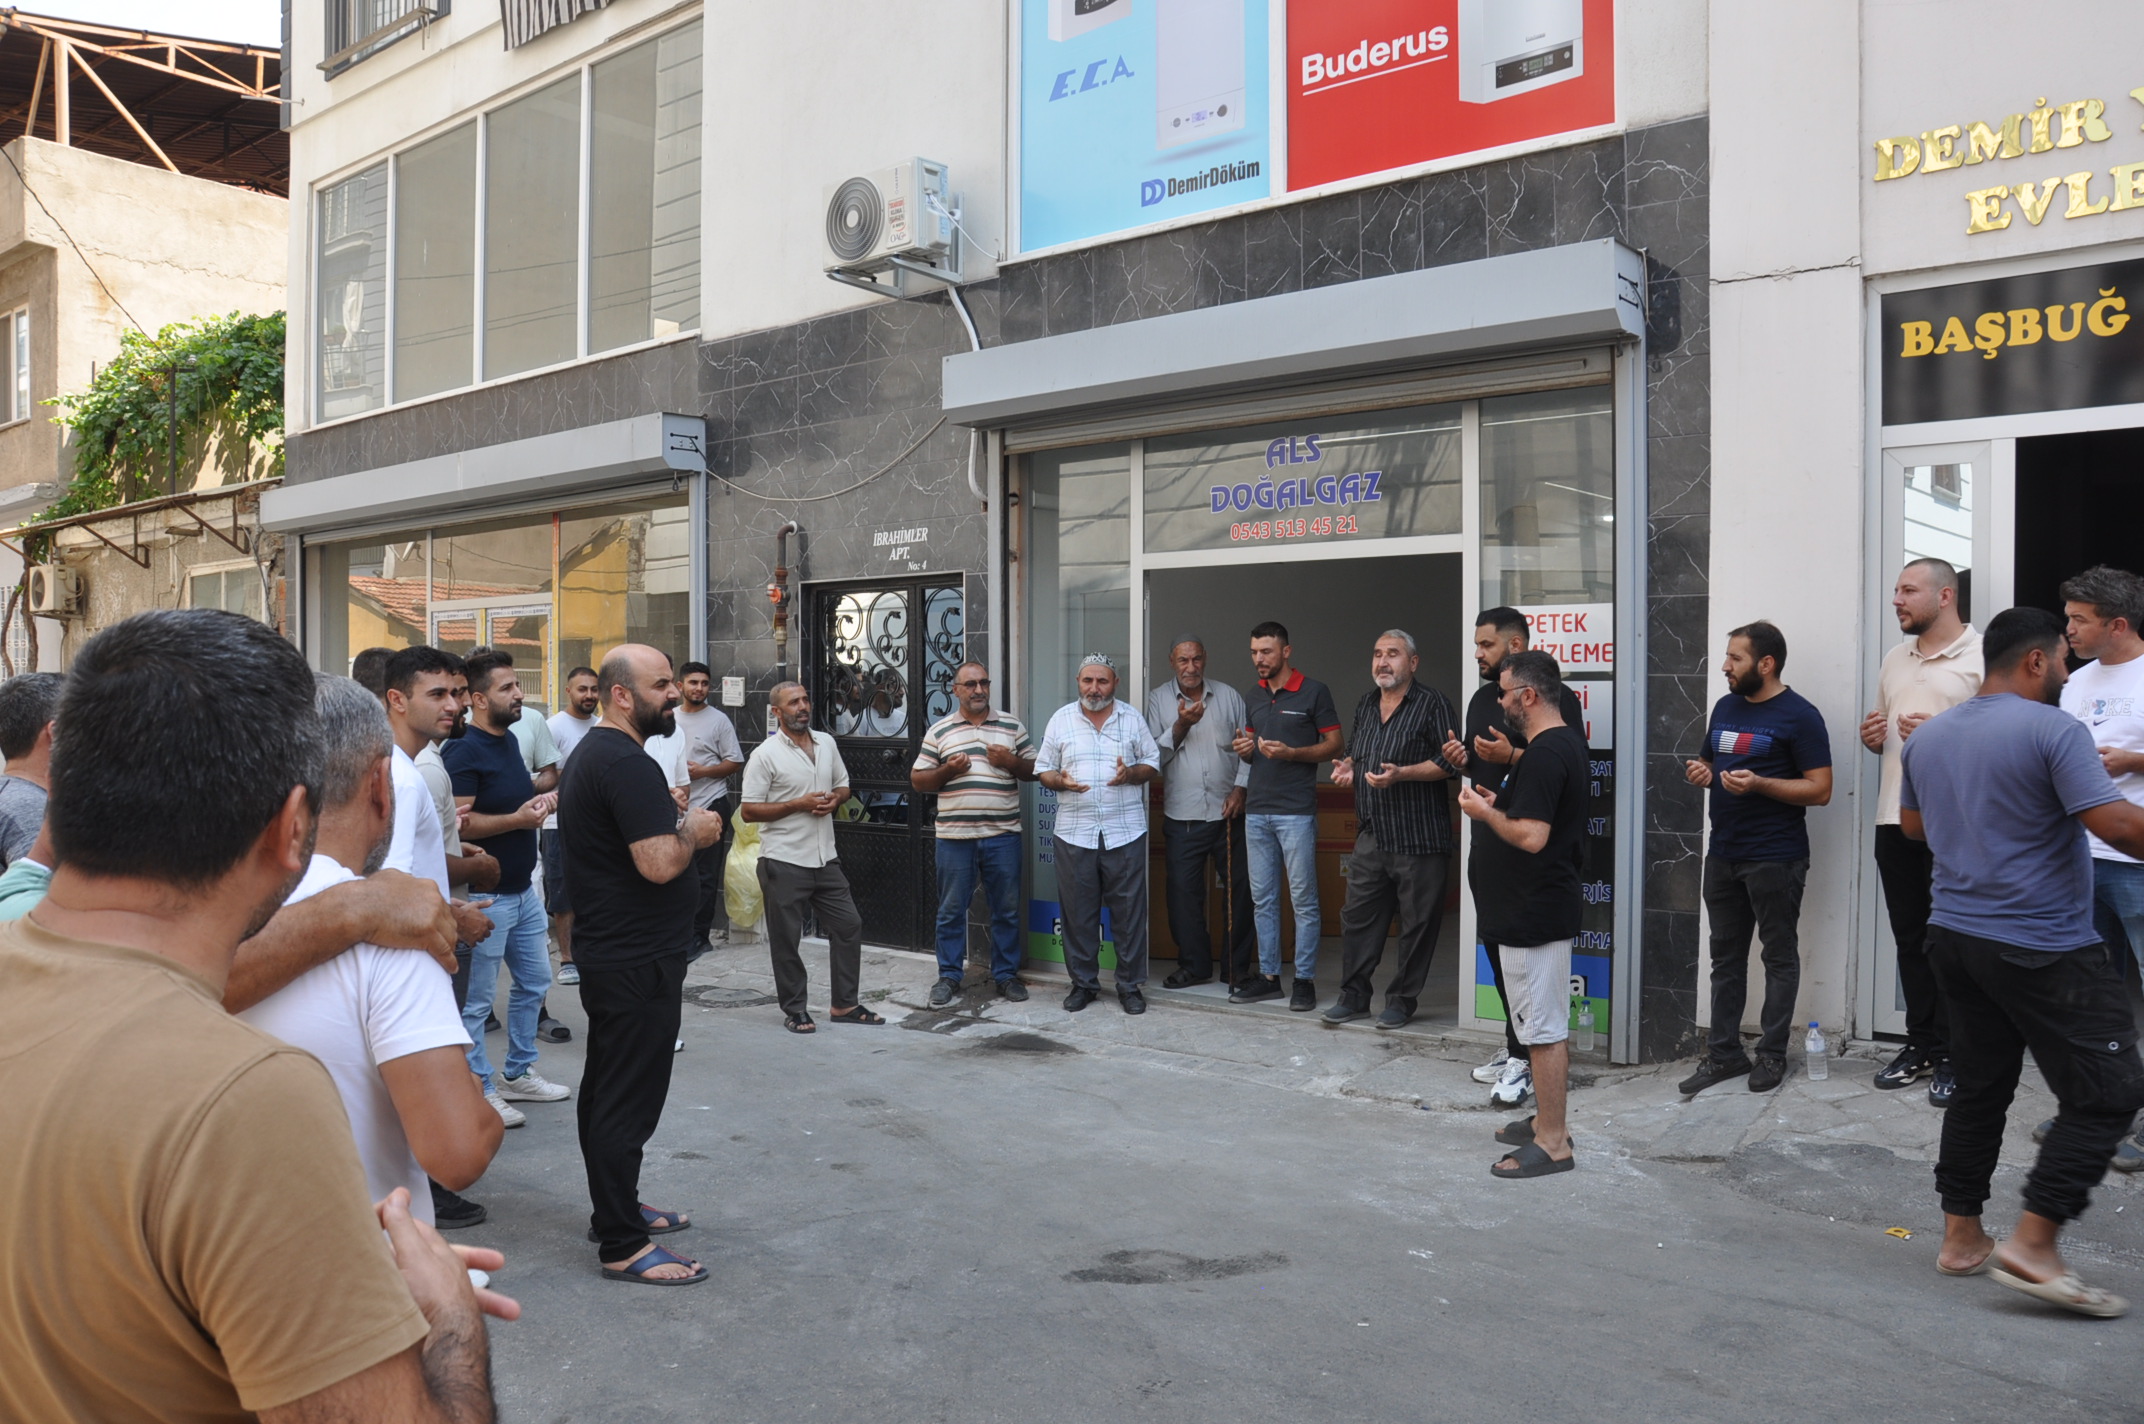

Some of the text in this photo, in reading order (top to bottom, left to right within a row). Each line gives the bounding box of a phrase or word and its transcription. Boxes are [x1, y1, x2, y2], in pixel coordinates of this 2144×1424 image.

[1302, 25, 1449, 86] Buderus
[1873, 96, 2113, 182] DEMİR
[1167, 160, 1260, 198] DemirDöküm
[1900, 286, 2130, 360] BAŞBUĞ
[1266, 433, 1322, 470] ALS
[1210, 471, 1382, 513] DOĞALGAZ
[873, 526, 928, 546] İBRAHİMLER
[1230, 514, 1358, 541] 0543 513 45 21
[889, 547, 910, 560] APT.
[921, 560, 927, 570] 4
[1525, 613, 1588, 633] PETEK
